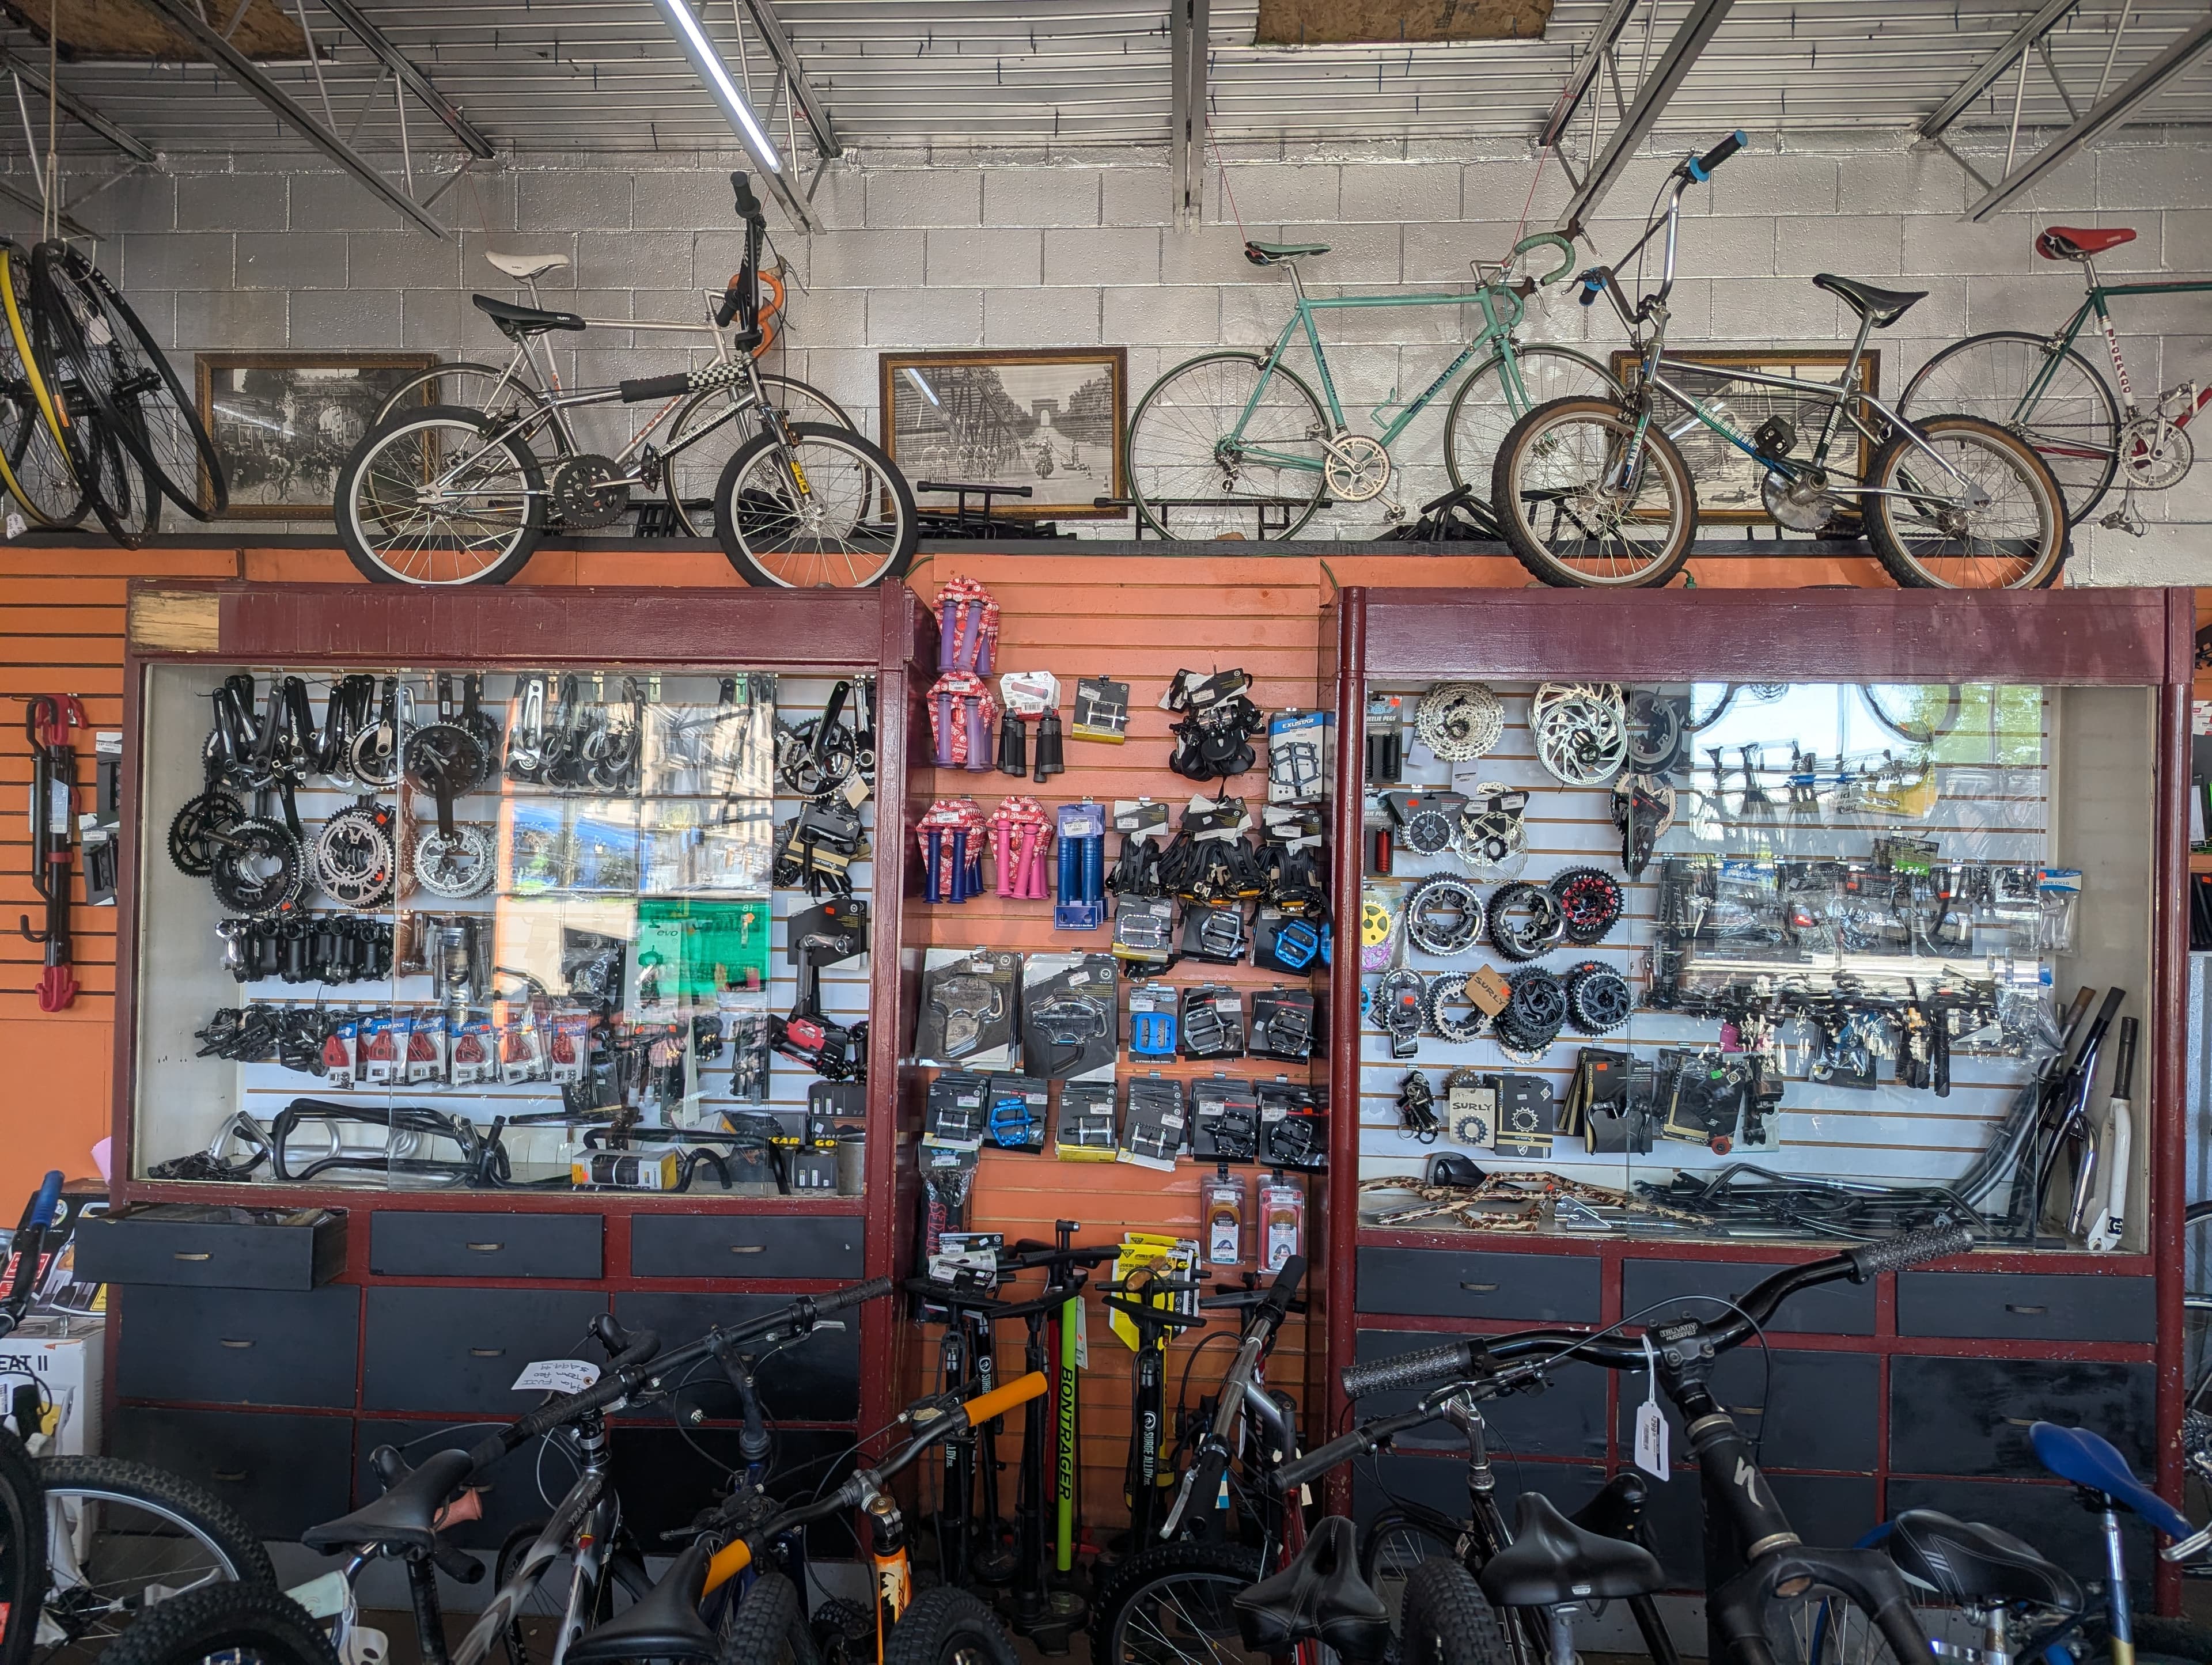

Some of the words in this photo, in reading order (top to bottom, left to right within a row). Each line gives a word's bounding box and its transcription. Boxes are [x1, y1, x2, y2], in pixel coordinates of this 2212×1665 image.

[1320, 357, 1338, 400] Bianchi
[1424, 351, 1469, 396] Bianchi
[2109, 337, 2132, 394] TORPADO
[632, 393, 684, 444] PEUGEO
[790, 460, 811, 494] 300
[1282, 718, 1315, 729] EXUSTAR
[1009, 813, 1035, 821] Shadow
[1673, 886, 1687, 938] TEKTRO
[1474, 975, 1507, 1007] SURLY
[377, 1022, 405, 1030] EXUSTAR
[1452, 1102, 1493, 1111] SURLY
[1660, 1322, 1698, 1338] TRUVATIV
[1059, 1368, 1074, 1500] BONTRAGER
[1143, 1431, 1154, 1455] SURGE
[1143, 1455, 1154, 1478] ALLOY
